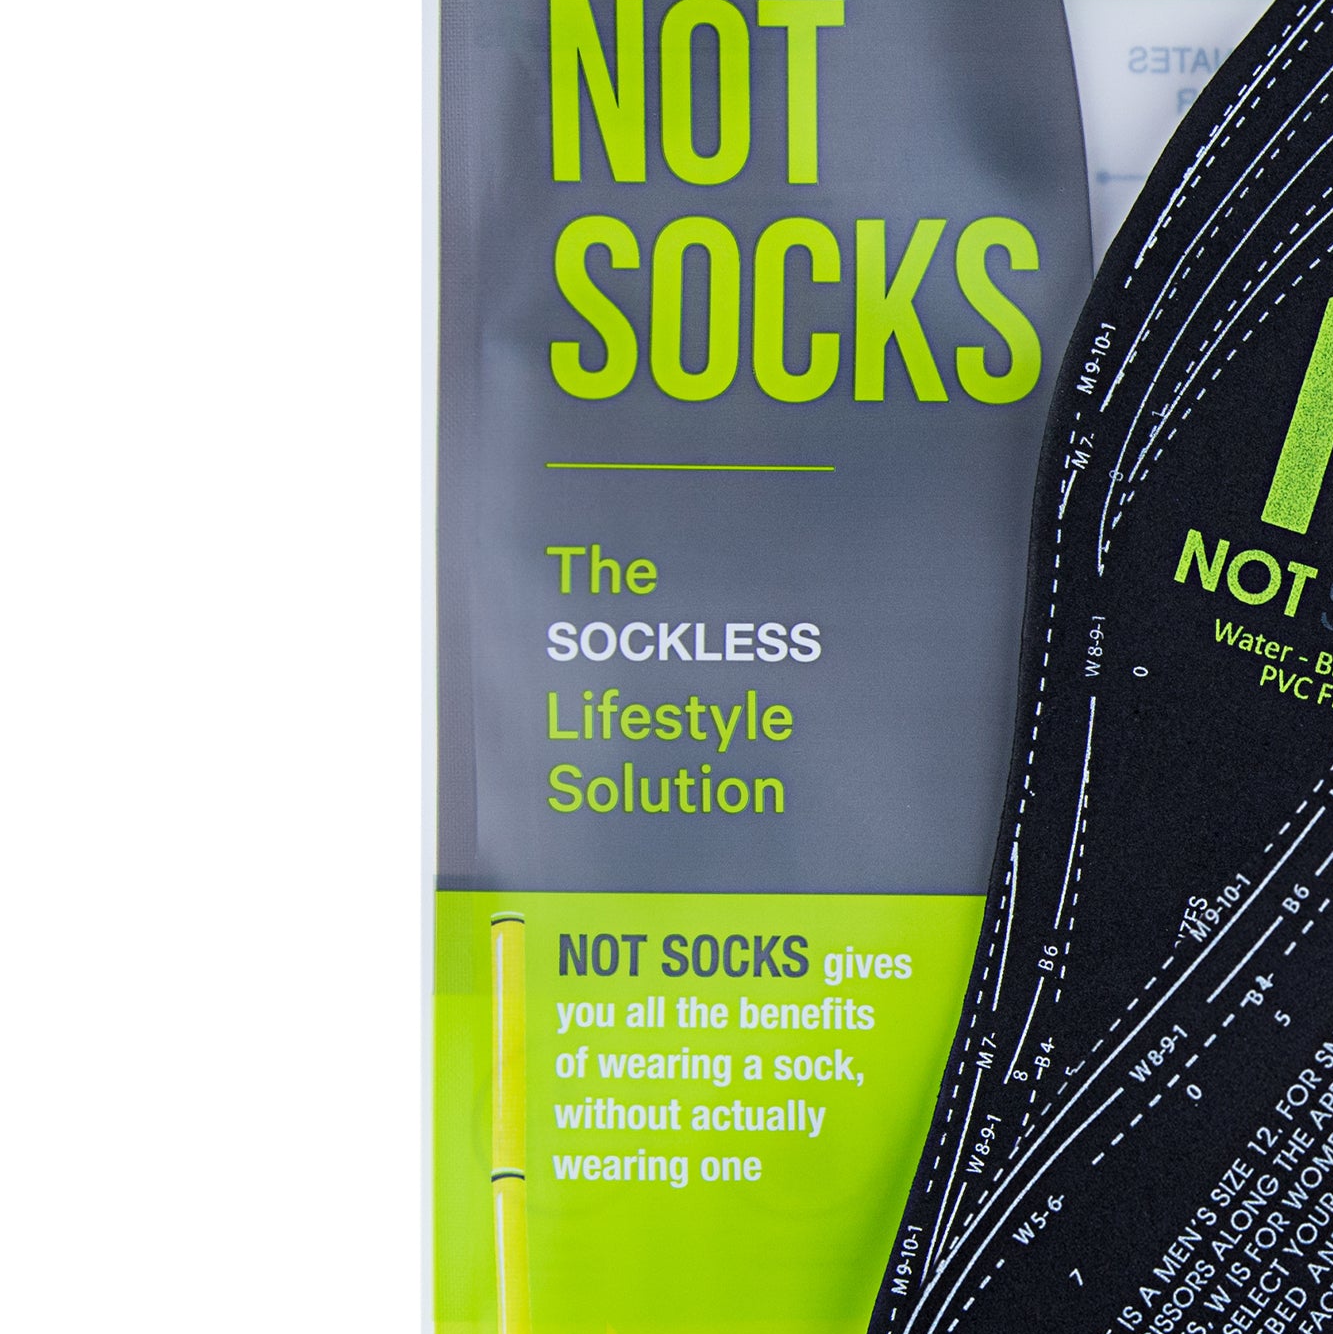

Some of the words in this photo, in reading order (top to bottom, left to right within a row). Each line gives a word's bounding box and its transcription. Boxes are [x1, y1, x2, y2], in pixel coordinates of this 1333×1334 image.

[549, 213, 1043, 405] SOCKS
[546, 543, 658, 595] The
[1173, 528, 1319, 618] NOT
[546, 621, 823, 663] SOCKLESS
[1213, 618, 1294, 665] Water
[1258, 664, 1314, 702] PVC
[547, 689, 794, 753] Lifestyle
[547, 762, 787, 815] Solution
[558, 933, 647, 978] NOT
[661, 933, 810, 979] SOCKS
[823, 945, 913, 986] gives
[556, 1002, 613, 1036] you
[626, 994, 666, 1029] all
[676, 996, 728, 1029] the
[738, 994, 876, 1031] benefits
[554, 1044, 589, 1080] of
[597, 1045, 734, 1089] wearing
[744, 1053, 764, 1081] a
[772, 1046, 865, 1087] sock,
[553, 1096, 682, 1133] without
[690, 1098, 827, 1139] actually
[552, 1148, 691, 1189] wearing
[699, 1153, 763, 1183] one
[1211, 1174, 1279, 1262] ALONG
[1272, 1127, 1315, 1172] THE
[1116, 1305, 1143, 1331] IS
[1138, 1286, 1162, 1308] A
[1210, 1157, 1255, 1207] SIZE
[1275, 1068, 1323, 1121] FOR
[1203, 1284, 1232, 1313] W
[1225, 1261, 1251, 1288] IS
[1243, 1211, 1291, 1263] FOR
